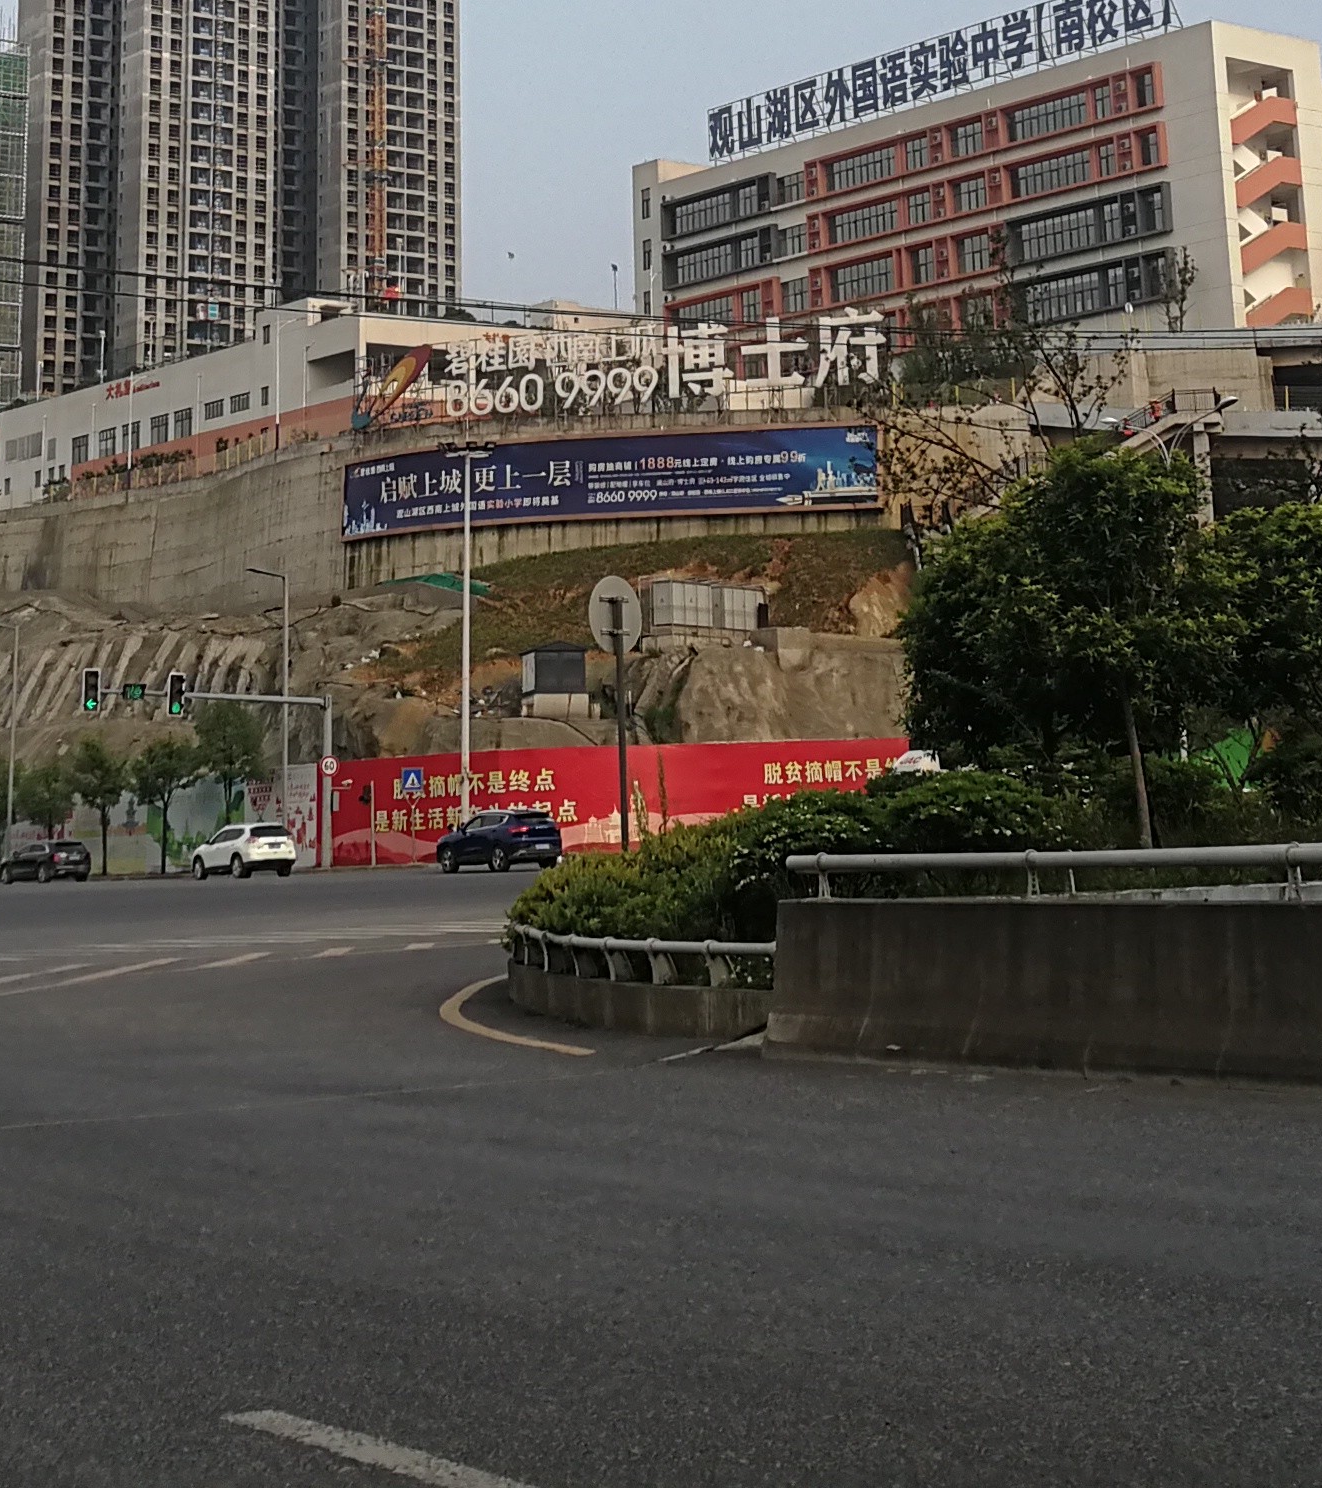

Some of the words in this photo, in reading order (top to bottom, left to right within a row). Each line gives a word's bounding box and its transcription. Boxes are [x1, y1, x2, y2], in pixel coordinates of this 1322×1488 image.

[661, 306, 888, 399] 博士府
[445, 374, 544, 417] 8660
[554, 364, 659, 409] 9999
[379, 468, 463, 504] 启赋上城
[473, 460, 572, 493] 更上一层
[596, 491, 626, 504] 8660
[627, 489, 658, 502] 9999
[324, 760, 335, 771] 60
